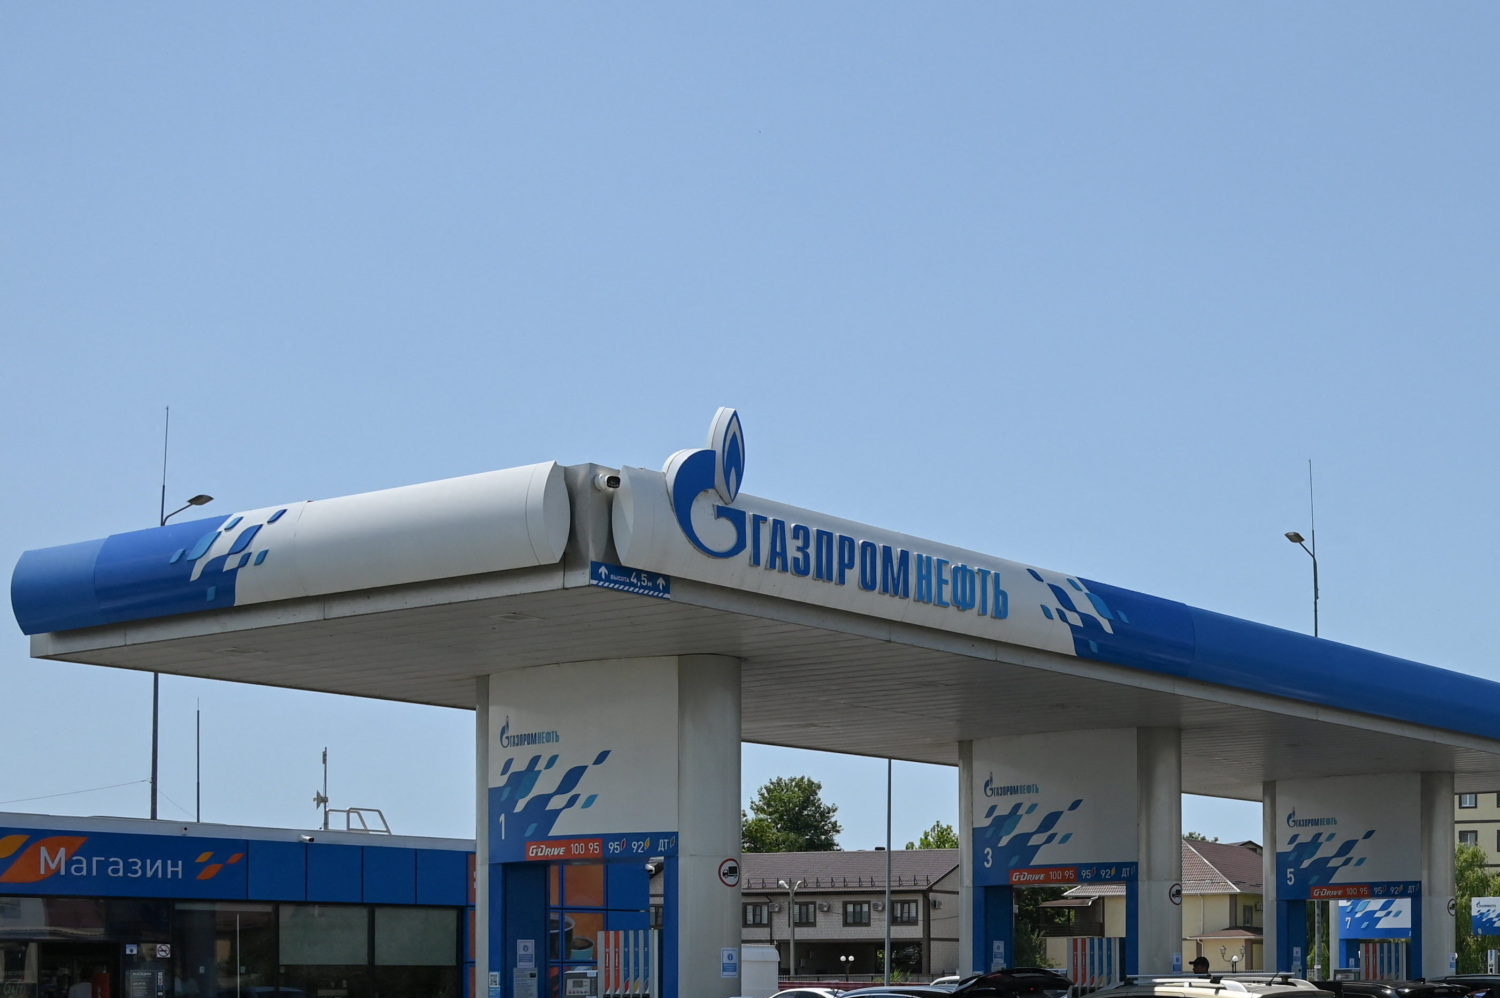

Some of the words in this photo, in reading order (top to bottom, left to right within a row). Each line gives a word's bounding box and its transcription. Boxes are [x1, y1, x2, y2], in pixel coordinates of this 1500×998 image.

[749, 512, 1009, 620] ГАЗПРОМНЕФТЬ
[509, 730, 560, 748] ГАЗПРОМНЕФТЬ
[993, 783, 1039, 797] ГАЗПРОМНЕФТЬ
[499, 813, 506, 840] 1
[570, 843, 585, 855] 100
[588, 842, 600, 854] 95
[608, 841, 620, 854] 95
[631, 841, 644, 853] 92
[658, 839, 669, 852] ДТ
[39, 846, 183, 879] Магазин
[983, 847, 993, 869] 3
[1049, 870, 1062, 880] 100
[1064, 870, 1075, 879] 95
[1081, 869, 1092, 879] 95
[1100, 869, 1111, 879] 92
[1121, 867, 1131, 878] ДТ
[1286, 868, 1295, 885] 5
[1346, 887, 1357, 895] 100
[1359, 887, 1368, 895] 95
[1373, 887, 1382, 895] 95
[1390, 887, 1399, 895] 92
[1345, 917, 1351, 929] 7
